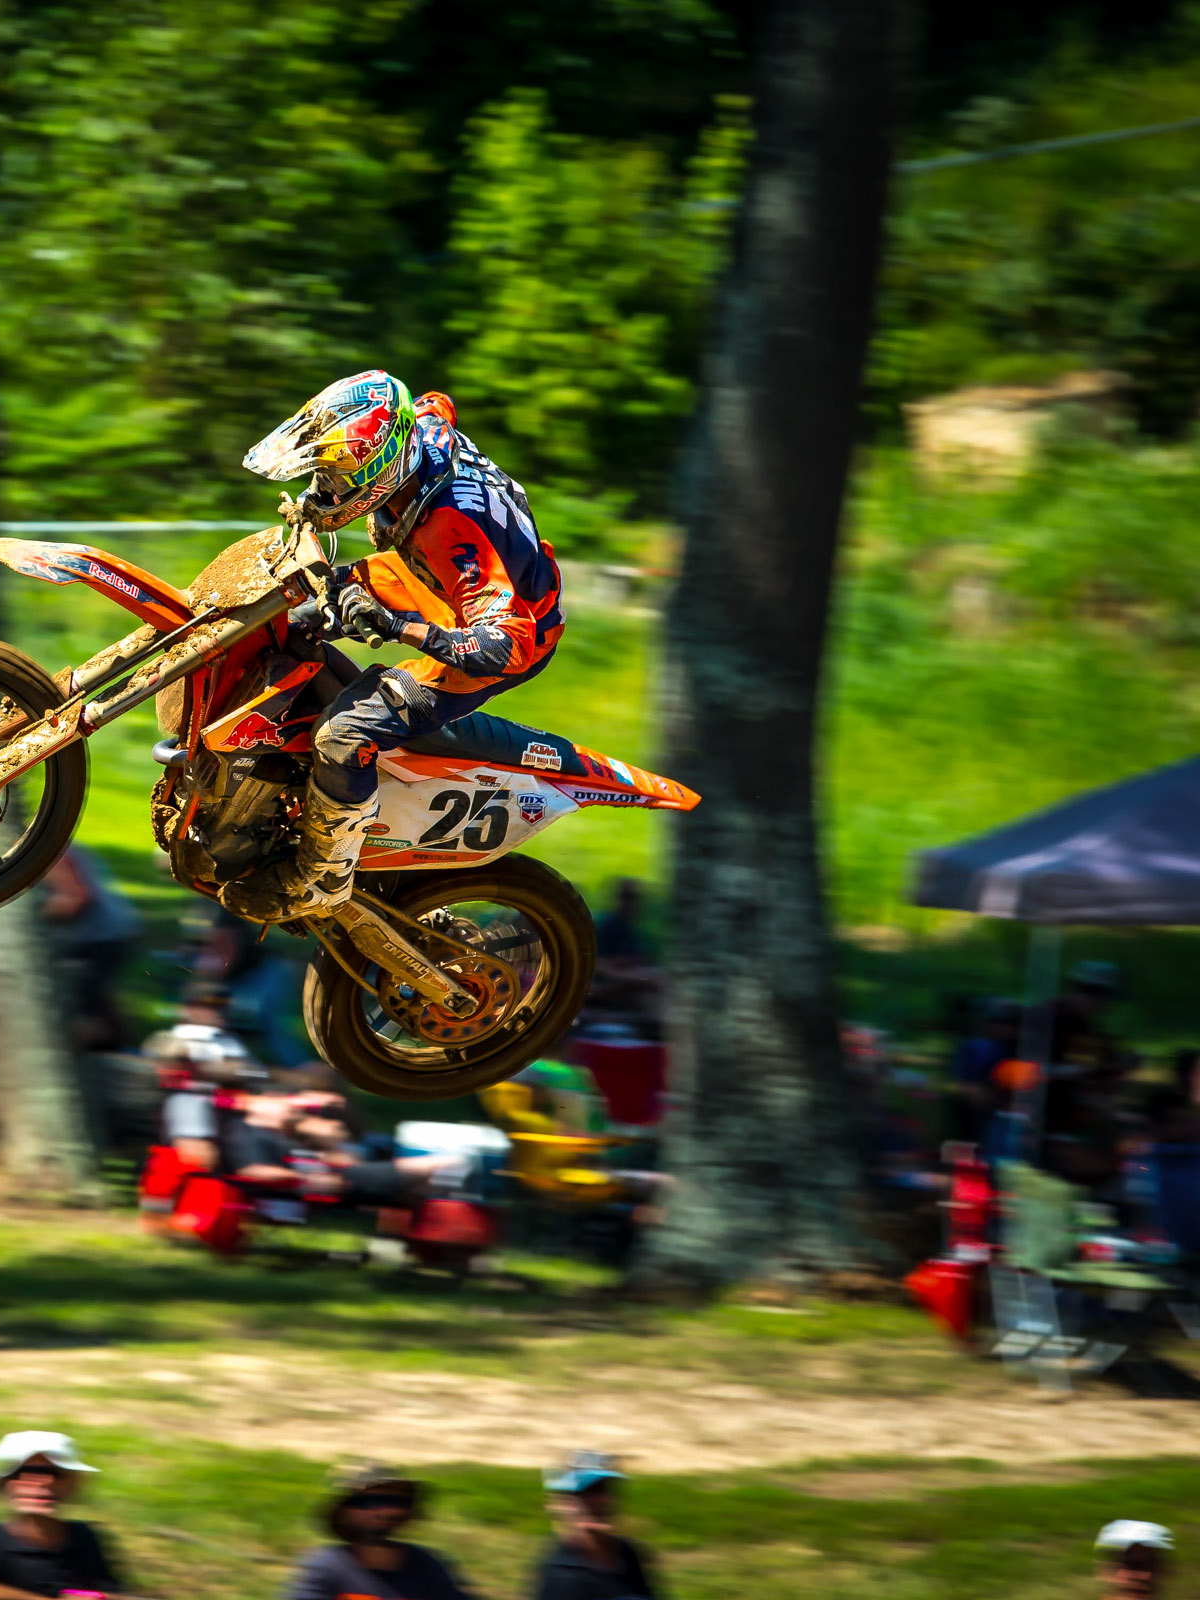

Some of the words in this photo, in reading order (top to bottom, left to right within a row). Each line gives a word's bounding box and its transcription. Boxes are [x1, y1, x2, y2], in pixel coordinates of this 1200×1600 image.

[351, 483, 390, 513] Bull
[89, 562, 116, 586] Red
[114, 578, 140, 599] Bull
[232, 757, 256, 767] KTM
[573, 791, 642, 803] DUNLOP
[418, 789, 510, 851] 25
[373, 839, 409, 848] MOTOREX
[381, 941, 428, 975] ENTHAL
